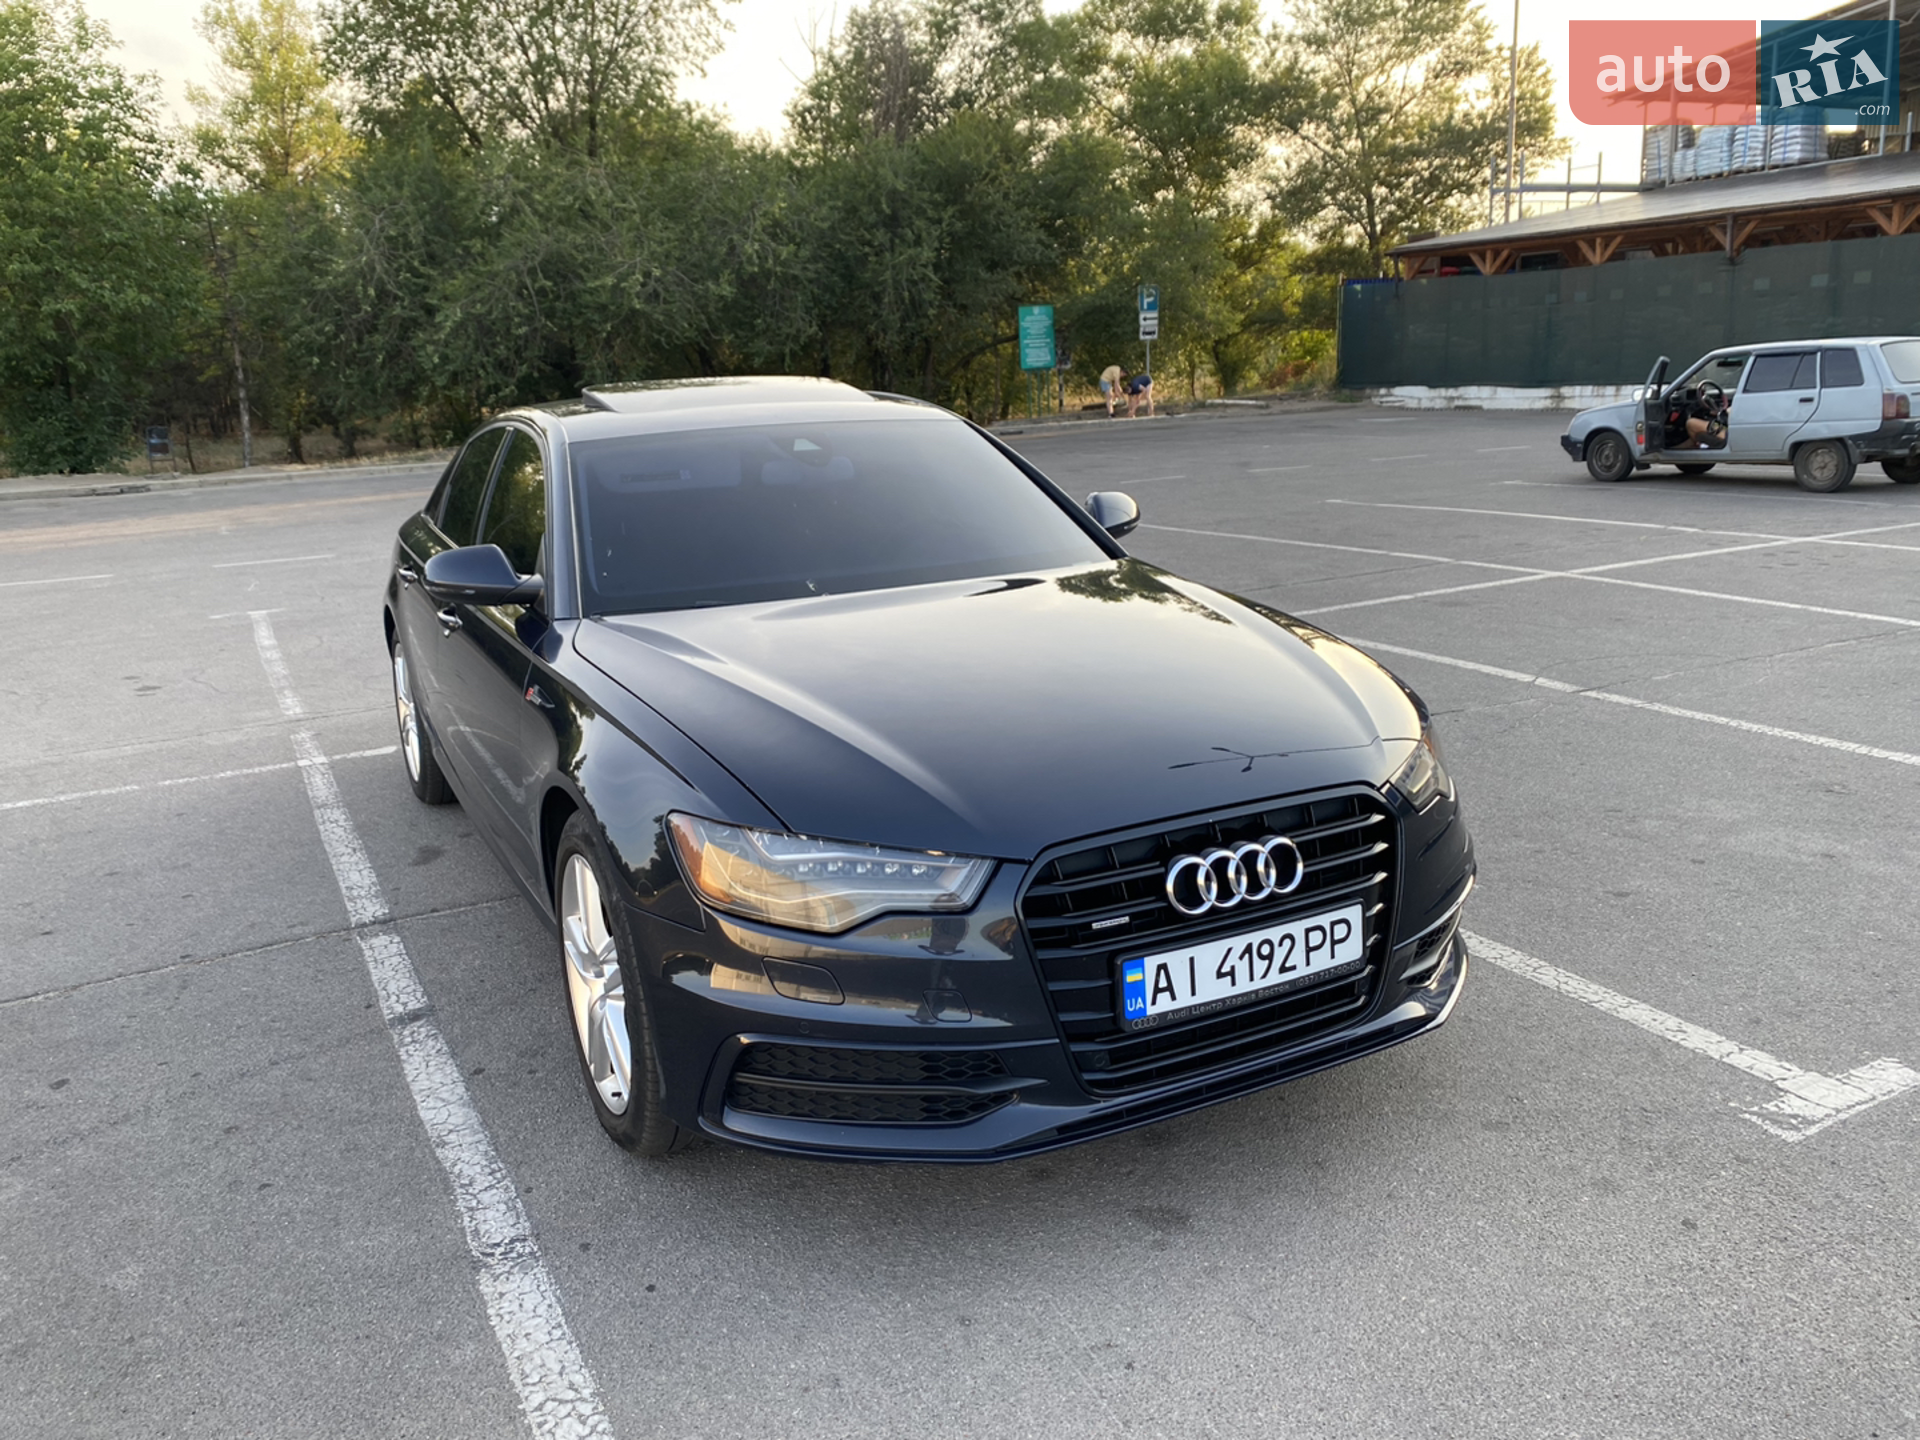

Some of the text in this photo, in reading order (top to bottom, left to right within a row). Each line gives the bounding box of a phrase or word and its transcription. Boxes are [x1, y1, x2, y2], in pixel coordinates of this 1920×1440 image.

[1143, 287, 1157, 310] P
[1150, 956, 1197, 1007] AI
[1127, 997, 1145, 1012] UA
[1166, 1007, 1190, 1022] Audi
